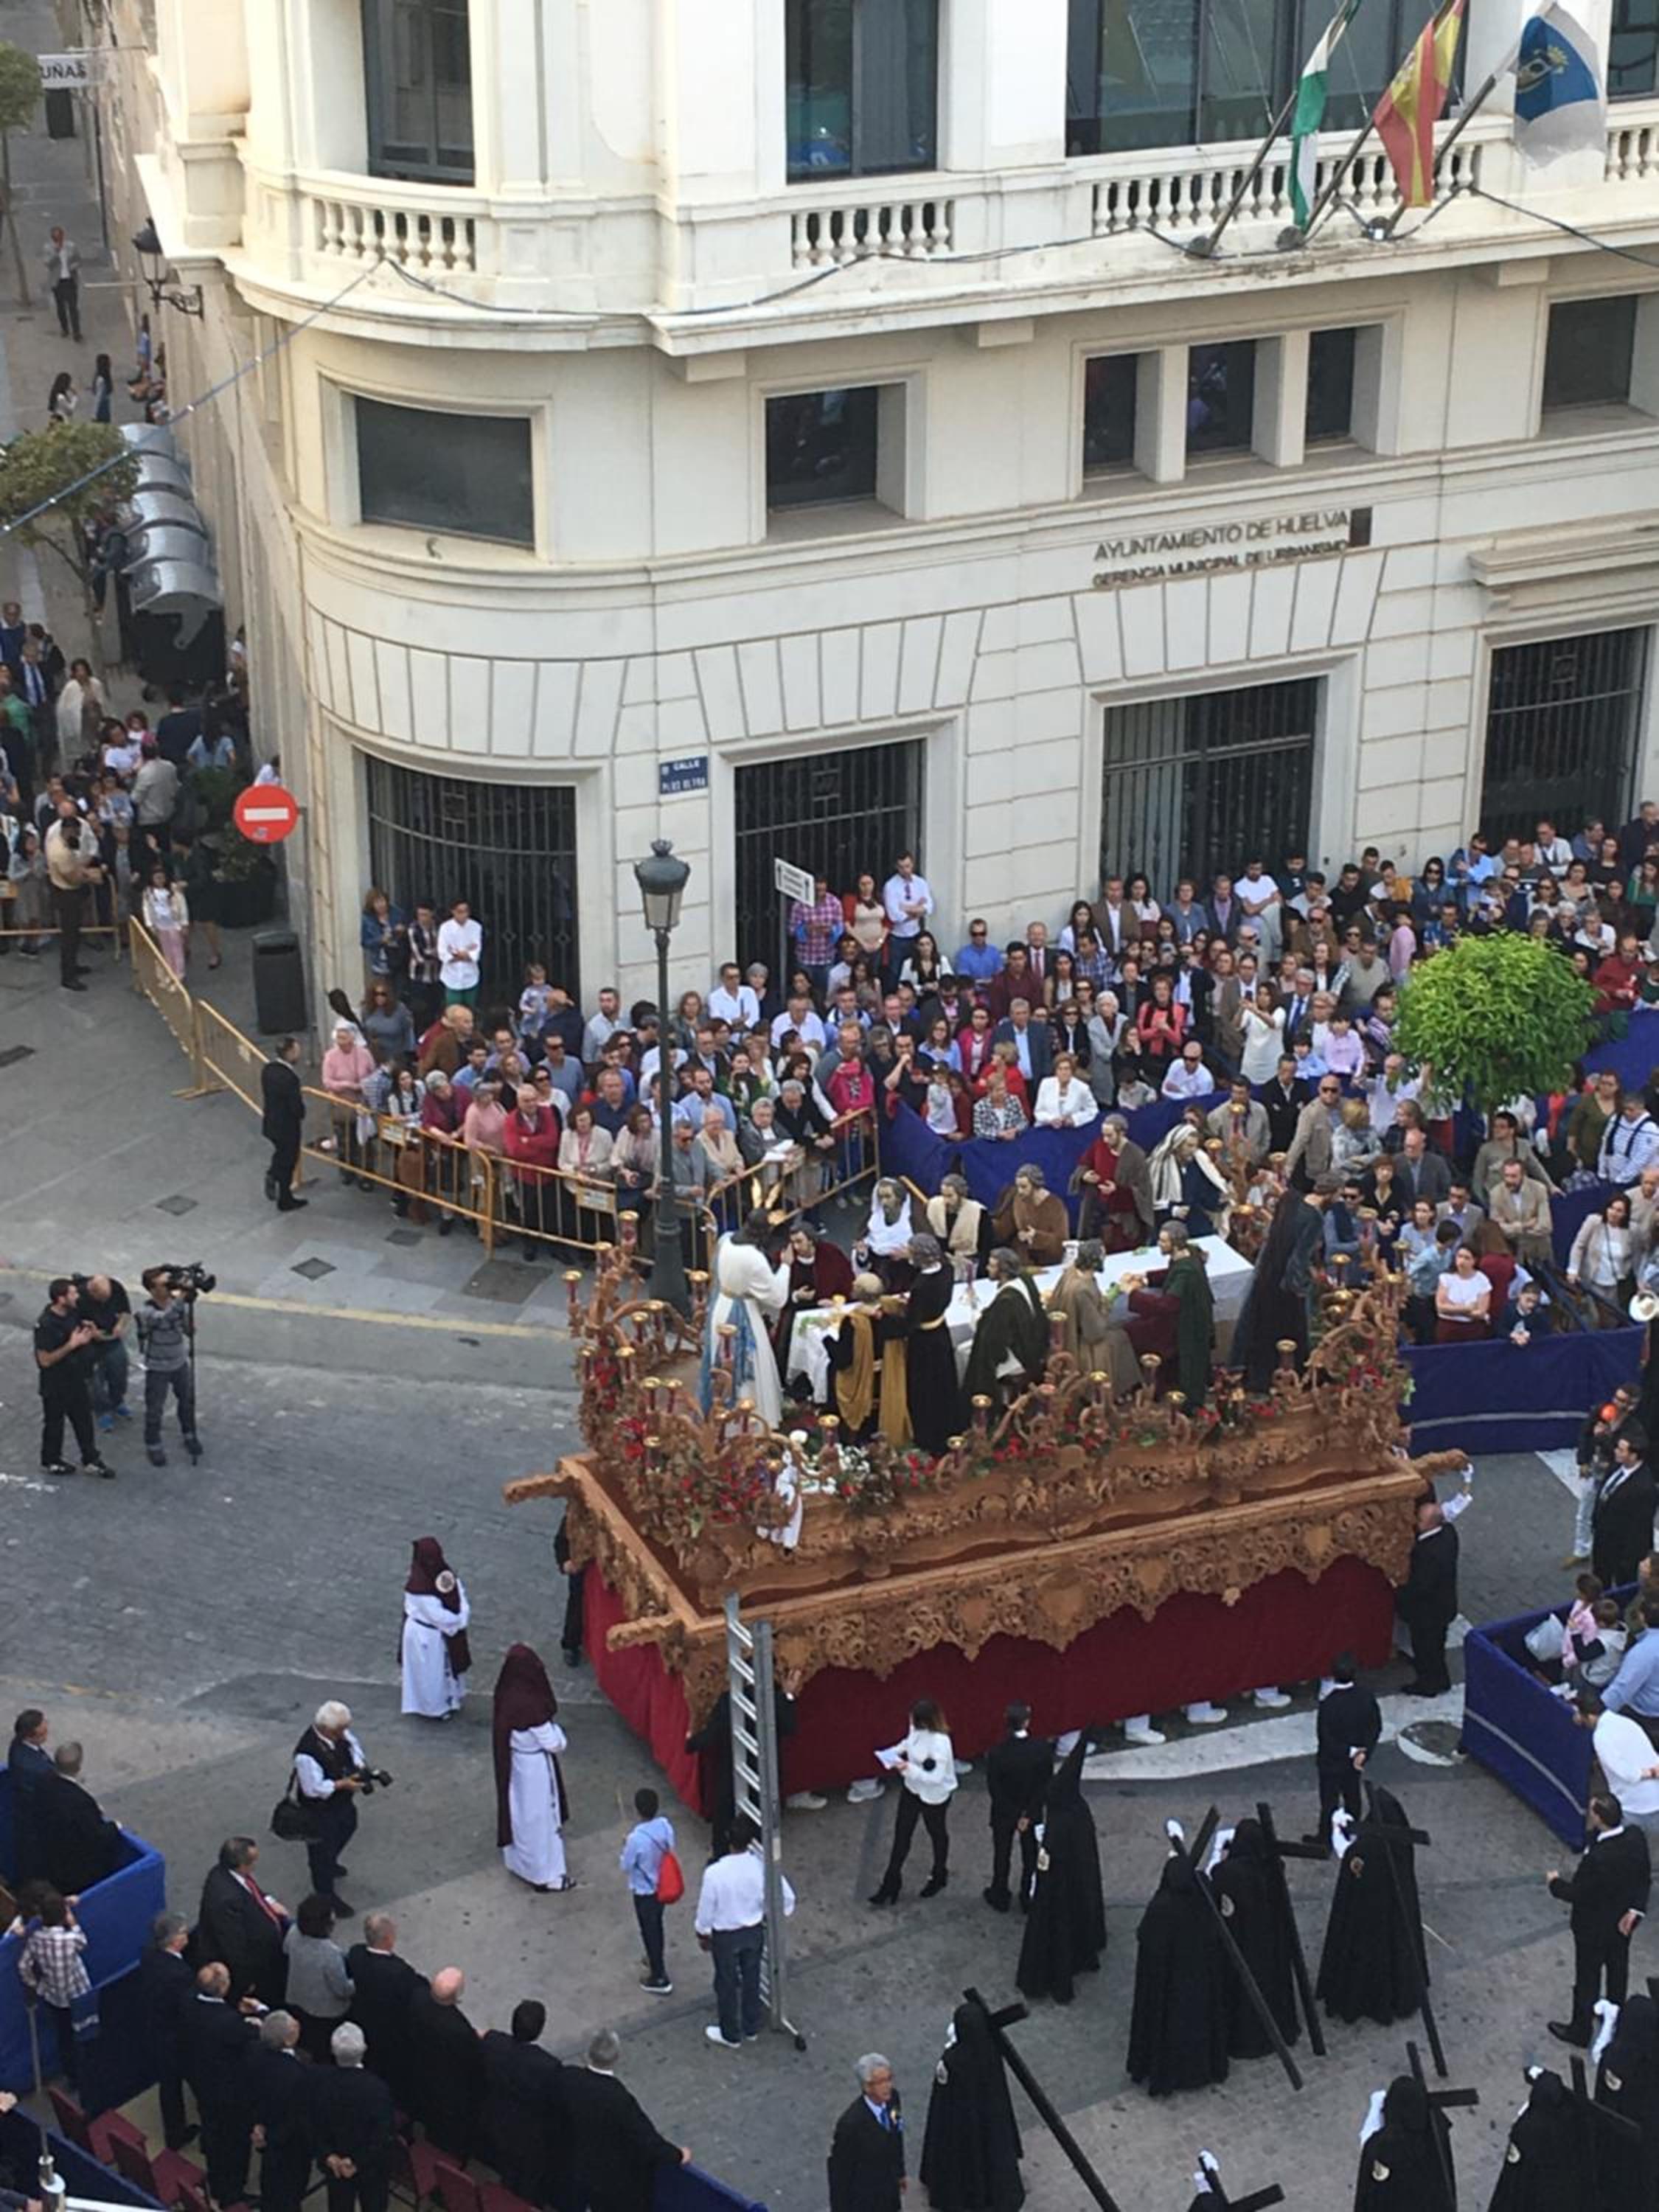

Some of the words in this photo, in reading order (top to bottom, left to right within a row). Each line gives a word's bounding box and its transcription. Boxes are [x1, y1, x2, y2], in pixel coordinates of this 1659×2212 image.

[1094, 525, 1242, 561] AYUNTAMIENTO
[1246, 521, 1270, 540] DE
[1276, 510, 1348, 535] HUELVA
[1093, 566, 1165, 587] GERENCIA
[1168, 554, 1239, 575] MUNICIPAL
[1245, 552, 1262, 565] DE
